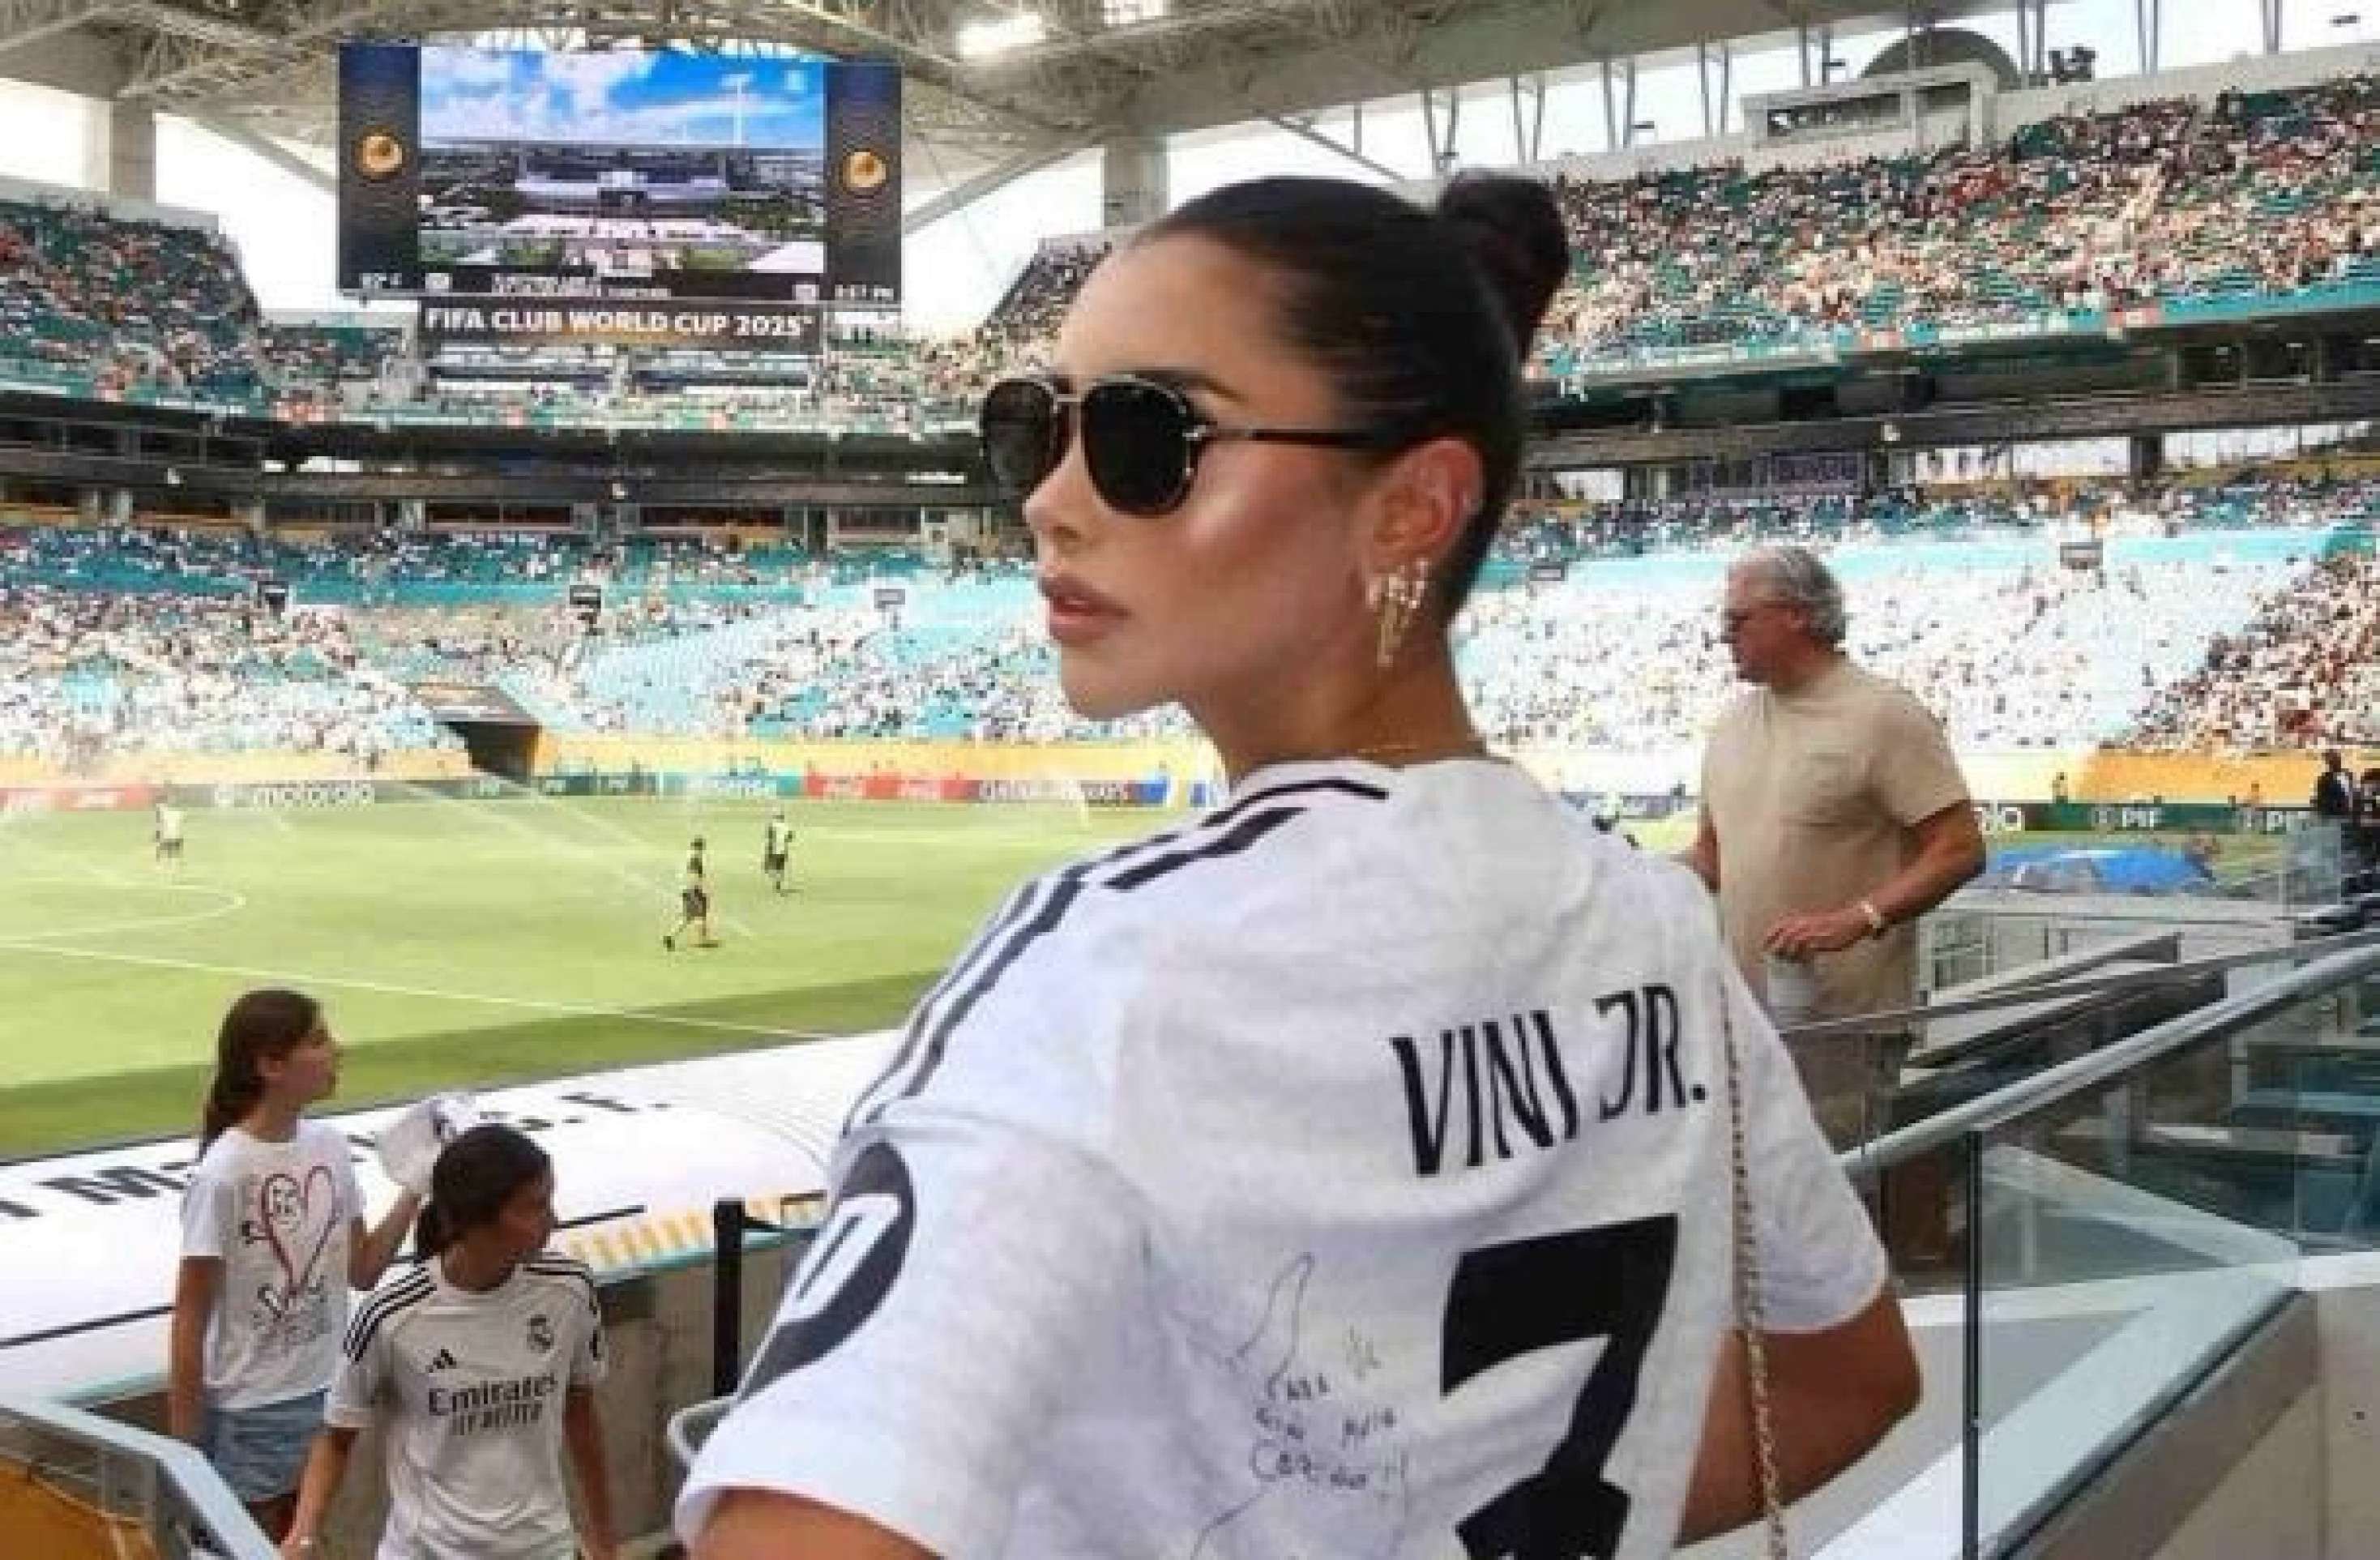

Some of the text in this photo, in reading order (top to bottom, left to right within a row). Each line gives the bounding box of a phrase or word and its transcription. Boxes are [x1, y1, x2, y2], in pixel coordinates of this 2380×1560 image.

[427, 307, 485, 331] FIFA
[491, 310, 563, 333] CLUB
[568, 311, 669, 333] WORLD
[673, 313, 728, 336] CUP
[1389, 982, 1708, 1177] VINI JR.
[429, 1372, 558, 1416] Emirates
[1440, 1212, 1679, 1560] 7
